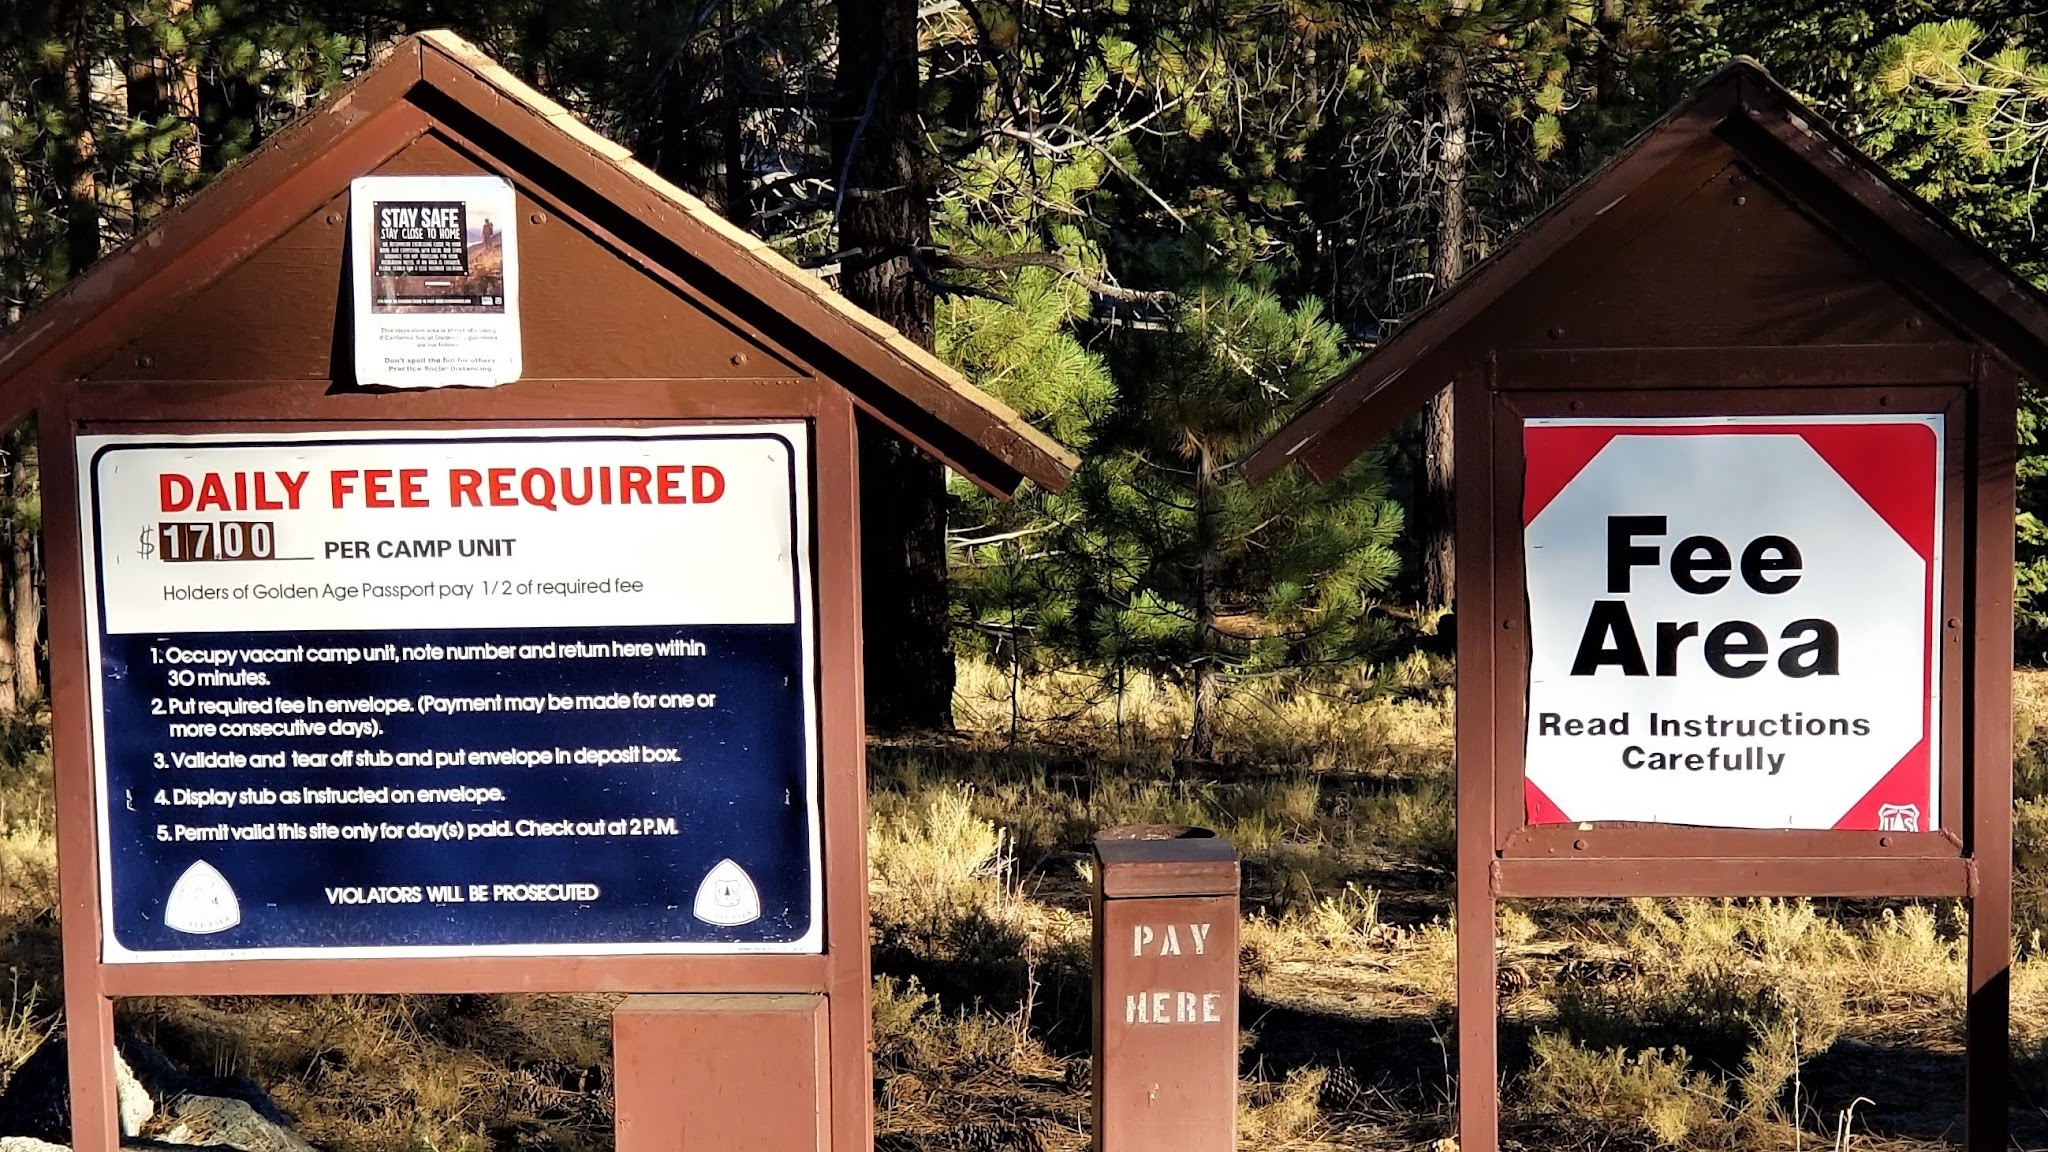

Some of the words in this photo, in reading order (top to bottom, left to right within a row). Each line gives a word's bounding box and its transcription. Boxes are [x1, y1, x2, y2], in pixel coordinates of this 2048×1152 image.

[381, 208, 418, 228] STAY
[421, 208, 459, 228] SAFE
[380, 228, 398, 240] STAY
[402, 228, 424, 240] CLOSE
[427, 228, 437, 239] TO
[439, 228, 461, 240] HOME
[407, 357, 426, 365] spoil
[159, 471, 310, 513] DAILY
[331, 468, 429, 509] FEE
[450, 465, 725, 511] REQUIRED
[324, 541, 370, 559] PER
[377, 539, 451, 559] CAMP
[458, 538, 516, 557] UNIT
[1607, 515, 1802, 595] Fee
[164, 584, 229, 601] Holders
[232, 584, 249, 600] of
[253, 584, 318, 600] Golden
[322, 583, 359, 601] Age
[362, 581, 434, 601] Passport
[439, 583, 474, 600] pay
[516, 579, 532, 595] of
[537, 578, 611, 598] required
[615, 578, 643, 593] fee
[1570, 600, 1840, 679] Area
[150, 648, 163, 664] 1.
[166, 647, 237, 666] Occupy
[240, 645, 303, 663] vacant
[306, 647, 361, 665] camp
[363, 644, 399, 663] unit,
[402, 643, 443, 661] note
[446, 643, 516, 660] number
[519, 642, 556, 659] and
[558, 642, 610, 658] return
[612, 640, 653, 657] here
[655, 639, 706, 657] within
[168, 670, 195, 687] 30
[198, 669, 271, 687] minutes.
[151, 698, 167, 715] 2.
[169, 697, 196, 715] Put
[199, 697, 272, 717] required
[275, 697, 305, 714] fee
[308, 696, 323, 713] in
[325, 696, 414, 716] envelope.
[417, 694, 502, 715] (Payment
[504, 697, 545, 714] may
[548, 693, 573, 711] be
[575, 692, 630, 710] made
[632, 691, 656, 709] for
[658, 694, 695, 709] one
[697, 693, 716, 708] or
[169, 722, 216, 738] more
[219, 719, 326, 737] consecutive
[329, 718, 384, 738] days).
[1538, 712, 1630, 737] Read
[1650, 712, 1871, 738] Instructions
[153, 752, 169, 769] 3.
[171, 751, 246, 769] Validate
[249, 750, 285, 769] and
[292, 750, 328, 768] tear
[331, 749, 353, 767] off
[355, 749, 393, 767] stub
[396, 749, 432, 767] and
[435, 748, 466, 769] put
[468, 747, 552, 768] envelope
[555, 746, 571, 764] in
[574, 746, 640, 767] deposit
[642, 745, 681, 763] box.
[1622, 745, 1786, 776] Carefully
[154, 789, 171, 806] 4.
[173, 788, 237, 808] Display
[239, 788, 277, 805] stub
[279, 791, 301, 805] as
[303, 787, 388, 805] instructed
[391, 790, 415, 804] on
[417, 785, 506, 805] envelope.
[157, 824, 173, 842] 5.
[174, 823, 229, 841] Permit
[231, 822, 275, 841] valid
[277, 822, 307, 840] this
[309, 822, 340, 840] site
[341, 821, 379, 842] only
[380, 821, 404, 839] for
[406, 820, 464, 842] day(s)
[467, 820, 513, 840] paid.
[515, 819, 576, 837] Check
[578, 819, 606, 836] out
[608, 819, 627, 836] at
[644, 818, 678, 836] P.M.
[325, 886, 422, 905] VIOLATORS
[426, 885, 464, 903] WILL
[469, 884, 490, 902] BE
[493, 883, 599, 902] PROSECUTED
[1133, 923, 1211, 957] PAY
[1125, 991, 1221, 1024] HERE
